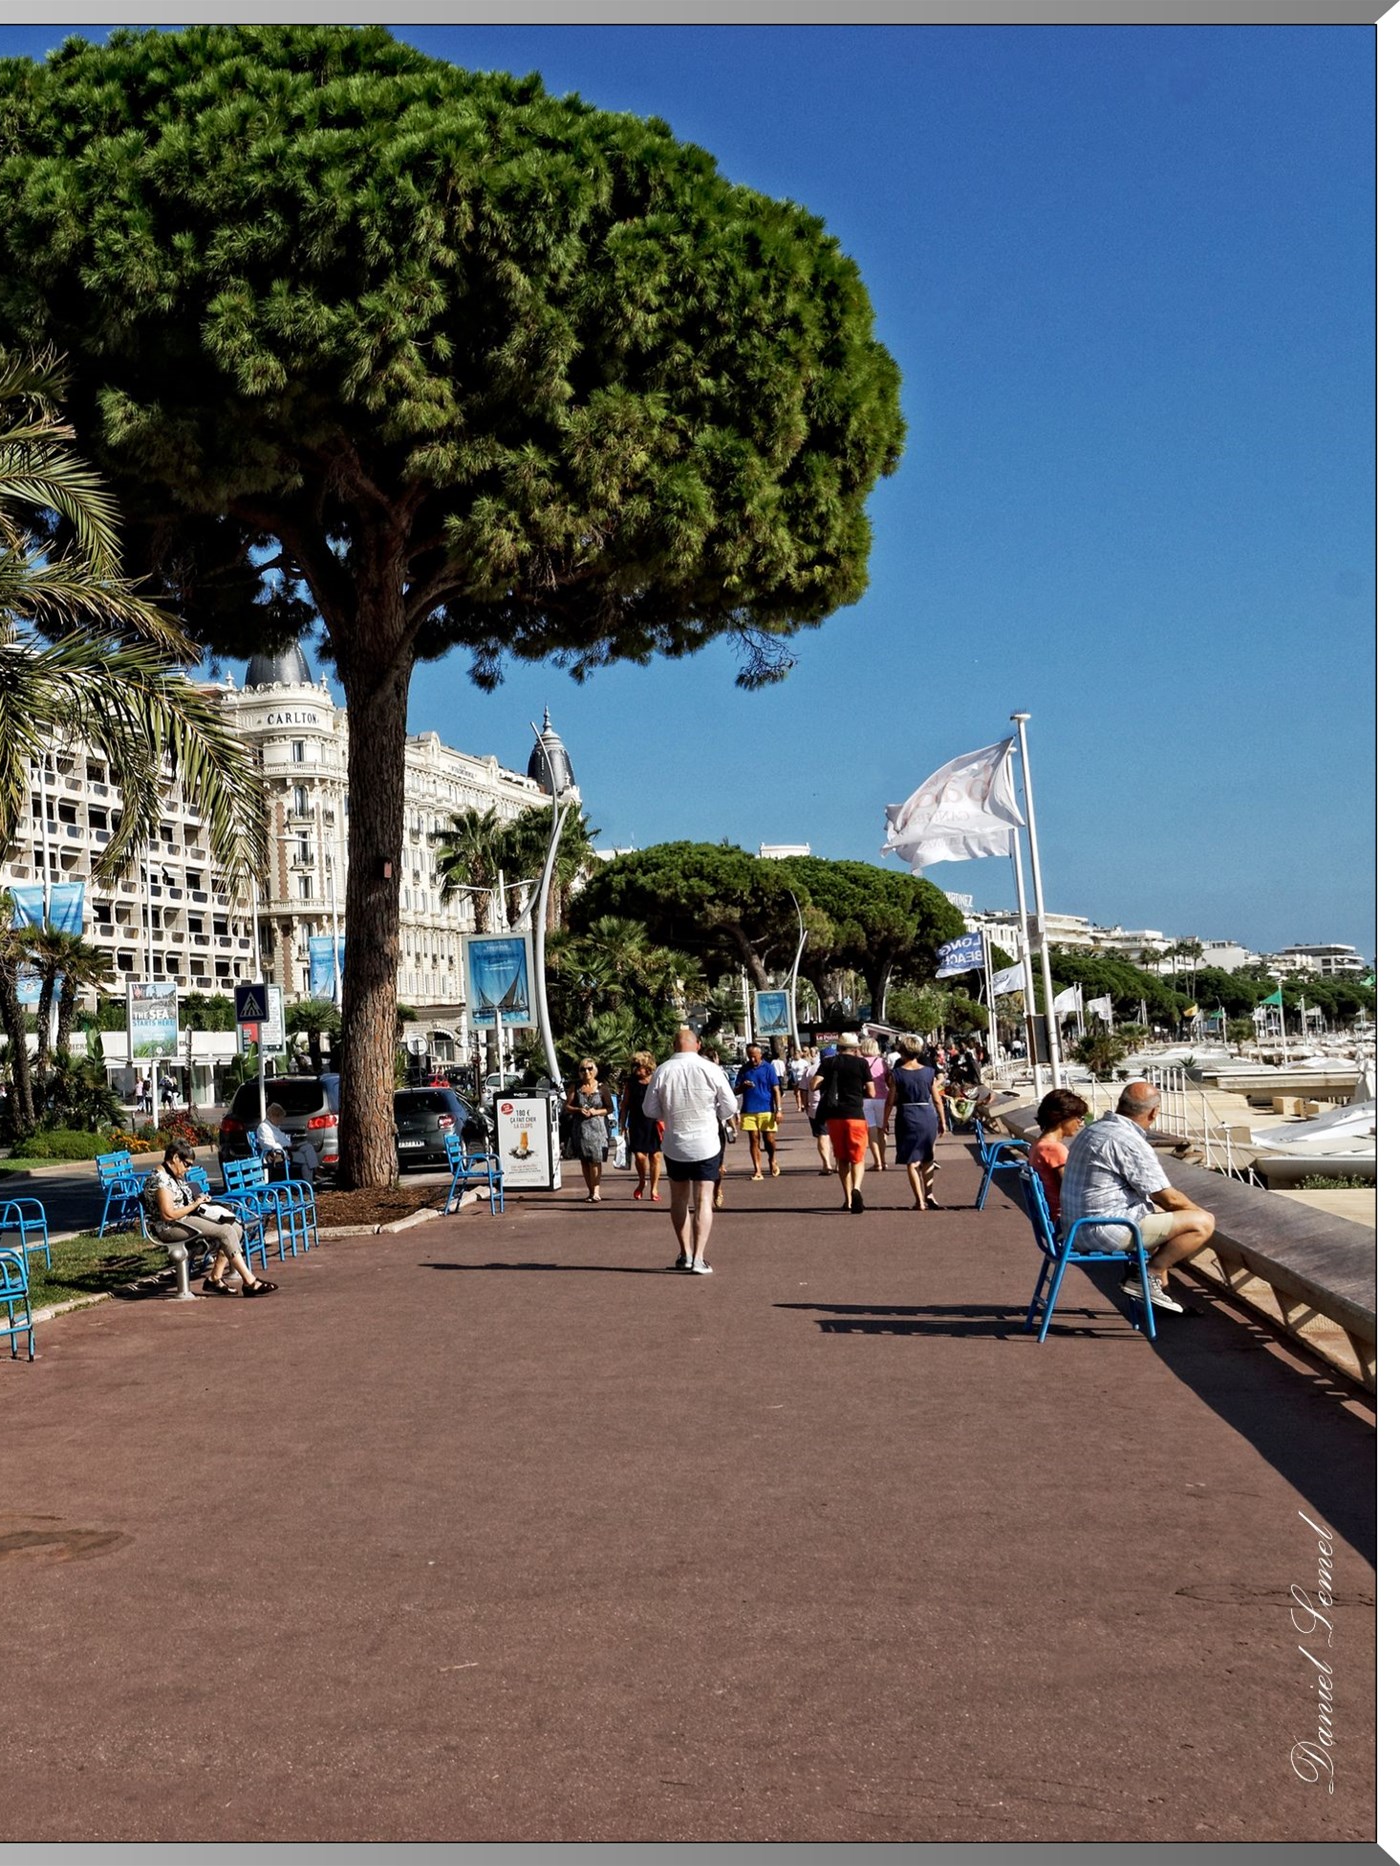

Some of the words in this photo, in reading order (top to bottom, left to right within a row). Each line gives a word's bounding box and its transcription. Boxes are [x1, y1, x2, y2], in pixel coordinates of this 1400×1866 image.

[266, 712, 317, 725] CARLTON
[134, 1011, 149, 1020] THE
[149, 1009, 169, 1020] SEA
[132, 1019, 156, 1027] STARTS
